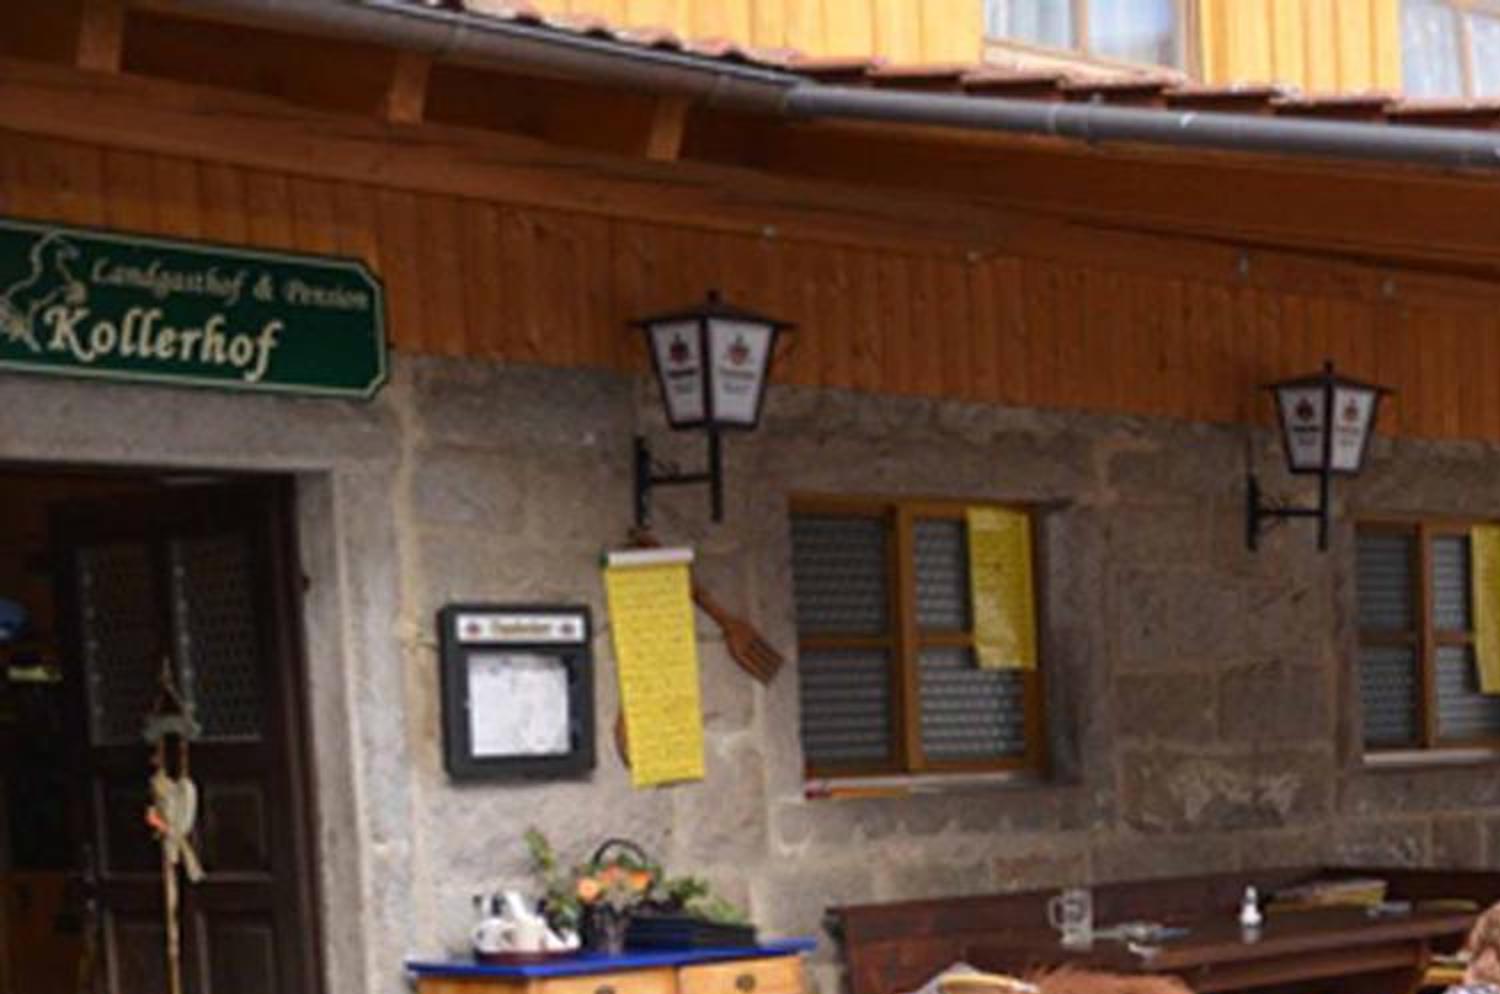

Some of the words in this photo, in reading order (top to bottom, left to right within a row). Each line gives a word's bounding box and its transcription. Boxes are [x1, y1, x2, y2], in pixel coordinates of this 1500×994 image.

[93, 257, 246, 305] Landgasthof
[253, 274, 274, 302] &
[286, 279, 370, 310] Pension
[44, 306, 283, 382] Kollerhof
